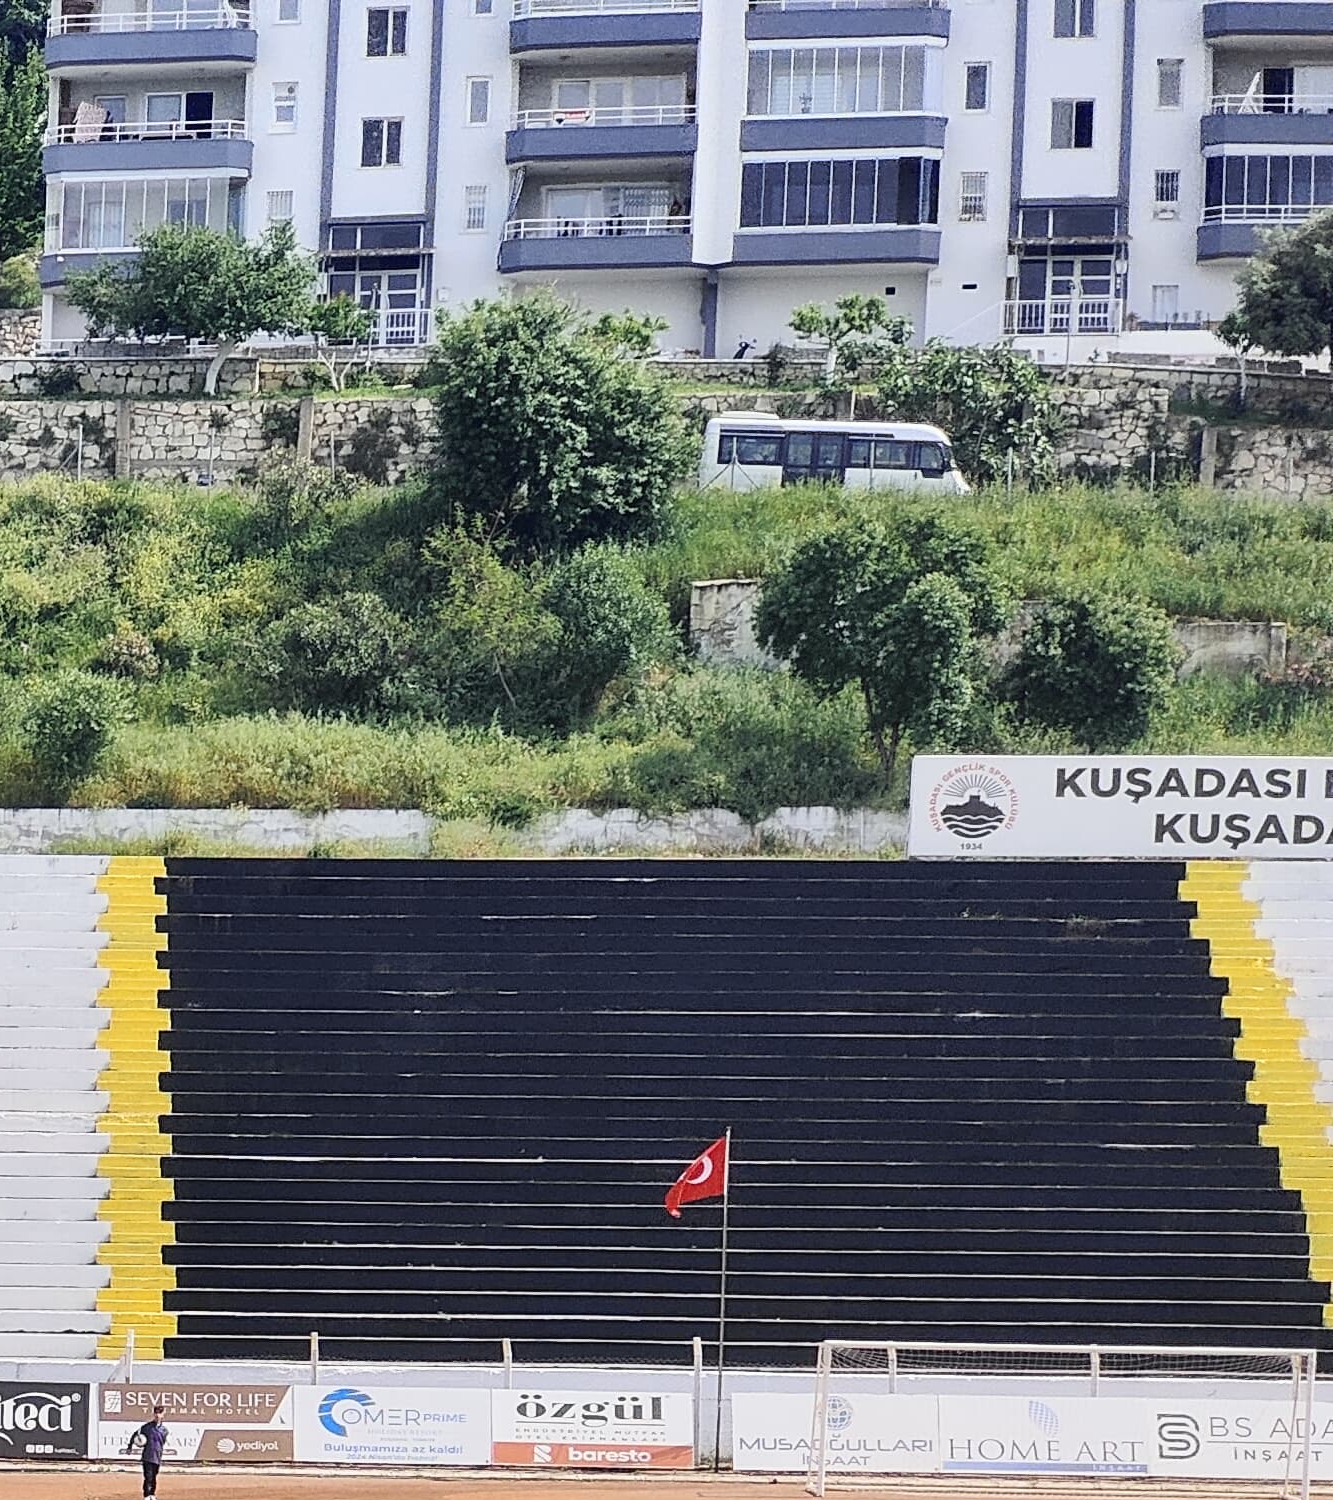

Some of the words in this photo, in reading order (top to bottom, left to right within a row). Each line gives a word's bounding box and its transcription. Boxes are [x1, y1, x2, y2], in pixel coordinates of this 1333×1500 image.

[1055, 767, 1306, 803] KUŞADASI
[1155, 813, 1333, 849] KUŞAD
[125, 1391, 187, 1408] SEVEN
[193, 1391, 232, 1408] FOR
[237, 1392, 277, 1408] LIFE
[142, 1407, 206, 1416] TRMAL
[423, 1413, 467, 1423] PRIME
[1209, 1416, 1253, 1438] BS
[235, 1440, 279, 1453] yediyol
[411, 1446, 427, 1454] az
[568, 1446, 652, 1463] baresto
[948, 1438, 1061, 1462] HOME
[1075, 1440, 1144, 1462] ART
